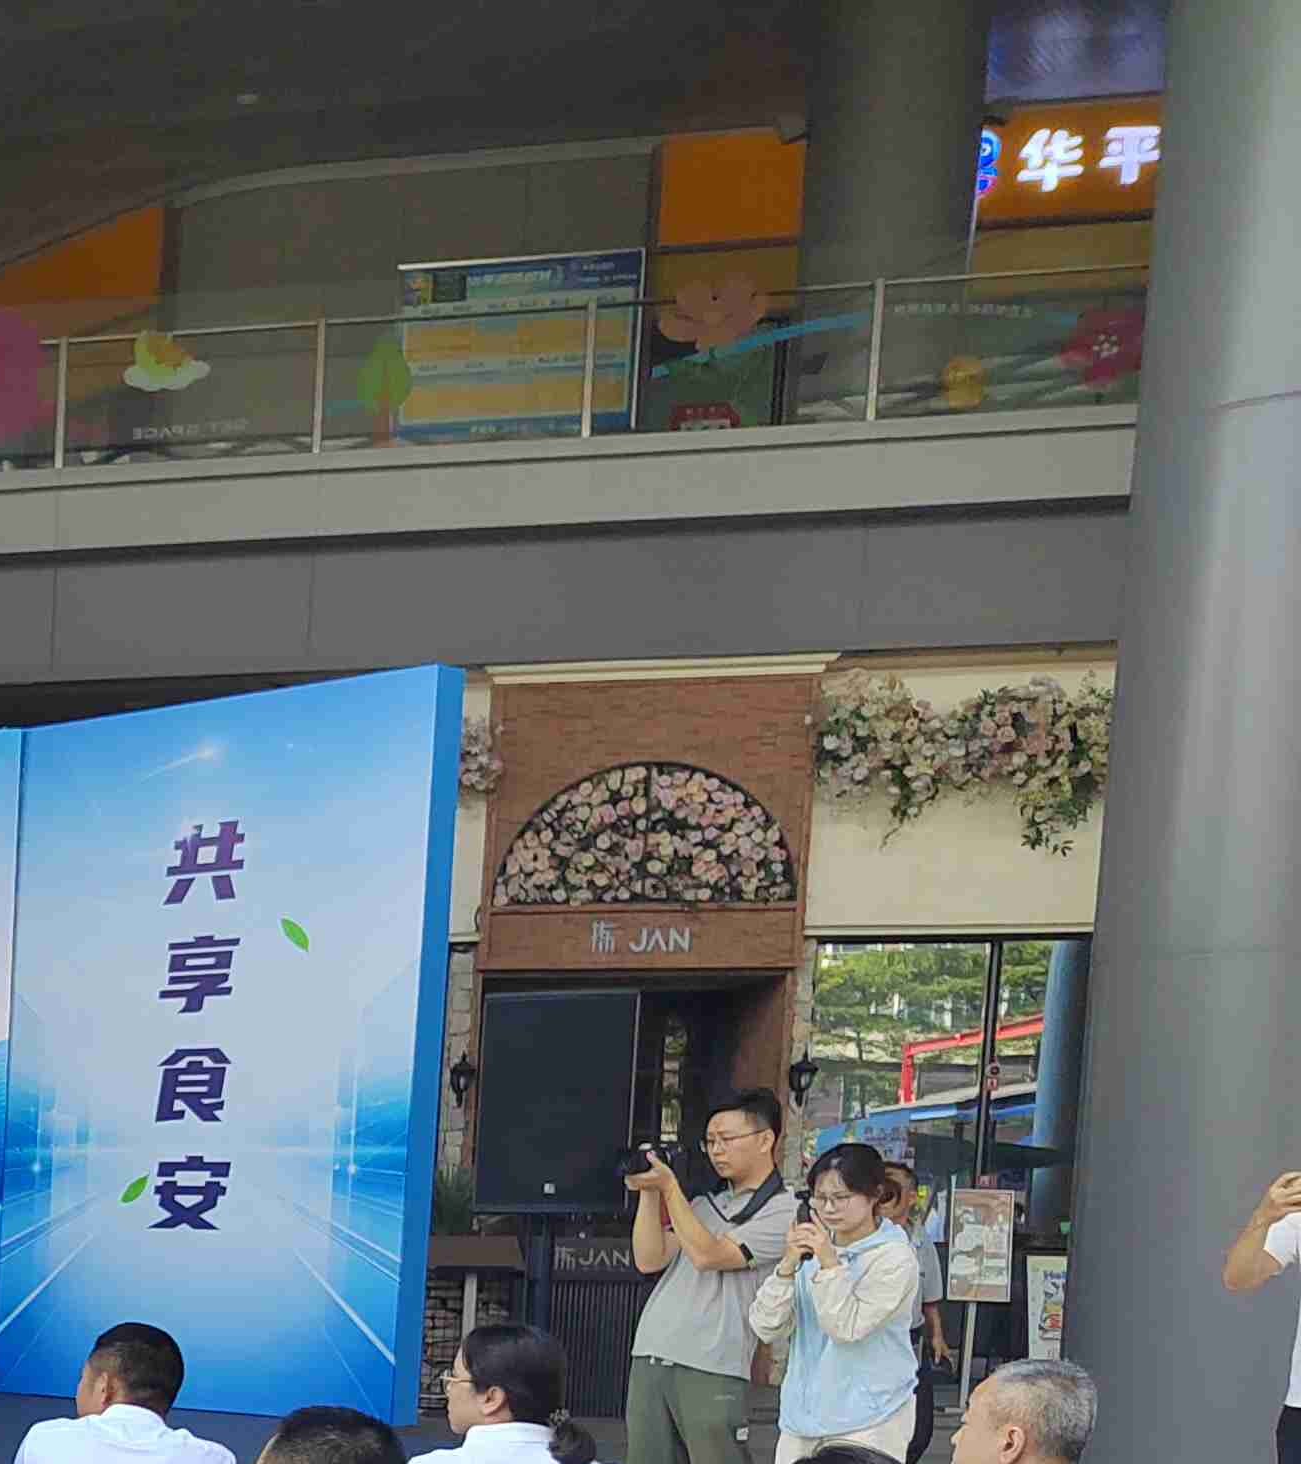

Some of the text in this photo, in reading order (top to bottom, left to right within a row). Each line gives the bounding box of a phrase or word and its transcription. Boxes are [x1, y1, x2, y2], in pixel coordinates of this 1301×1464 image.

[147, 819, 245, 1231] 共享食安
[628, 927, 691, 953] JAN
